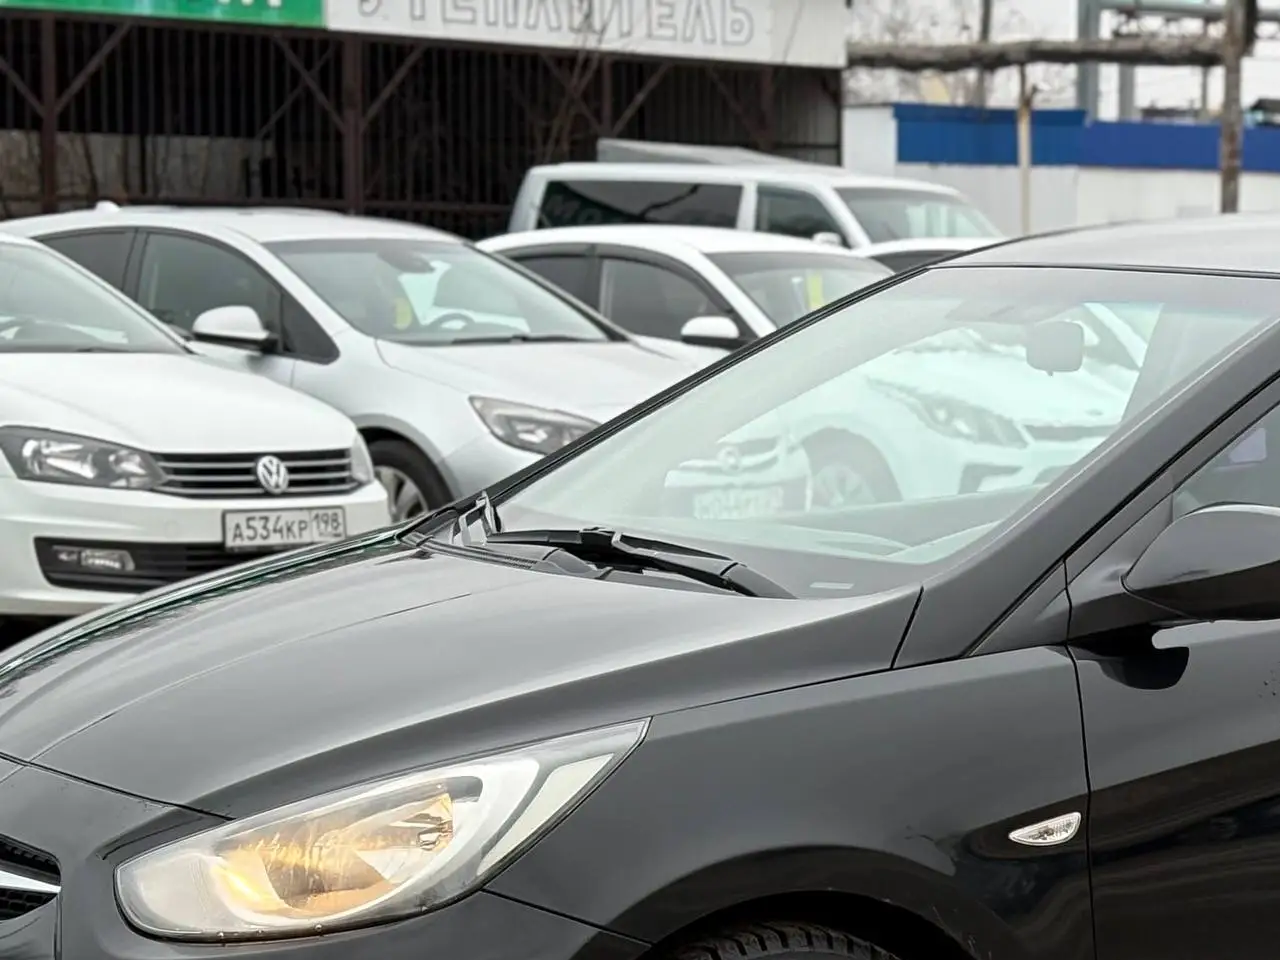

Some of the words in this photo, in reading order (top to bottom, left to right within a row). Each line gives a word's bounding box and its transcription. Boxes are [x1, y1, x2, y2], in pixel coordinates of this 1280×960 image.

[357, 0, 754, 46] ЛИТЕЛЬ
[232, 514, 308, 543] А534КР
[313, 512, 341, 532] 198
